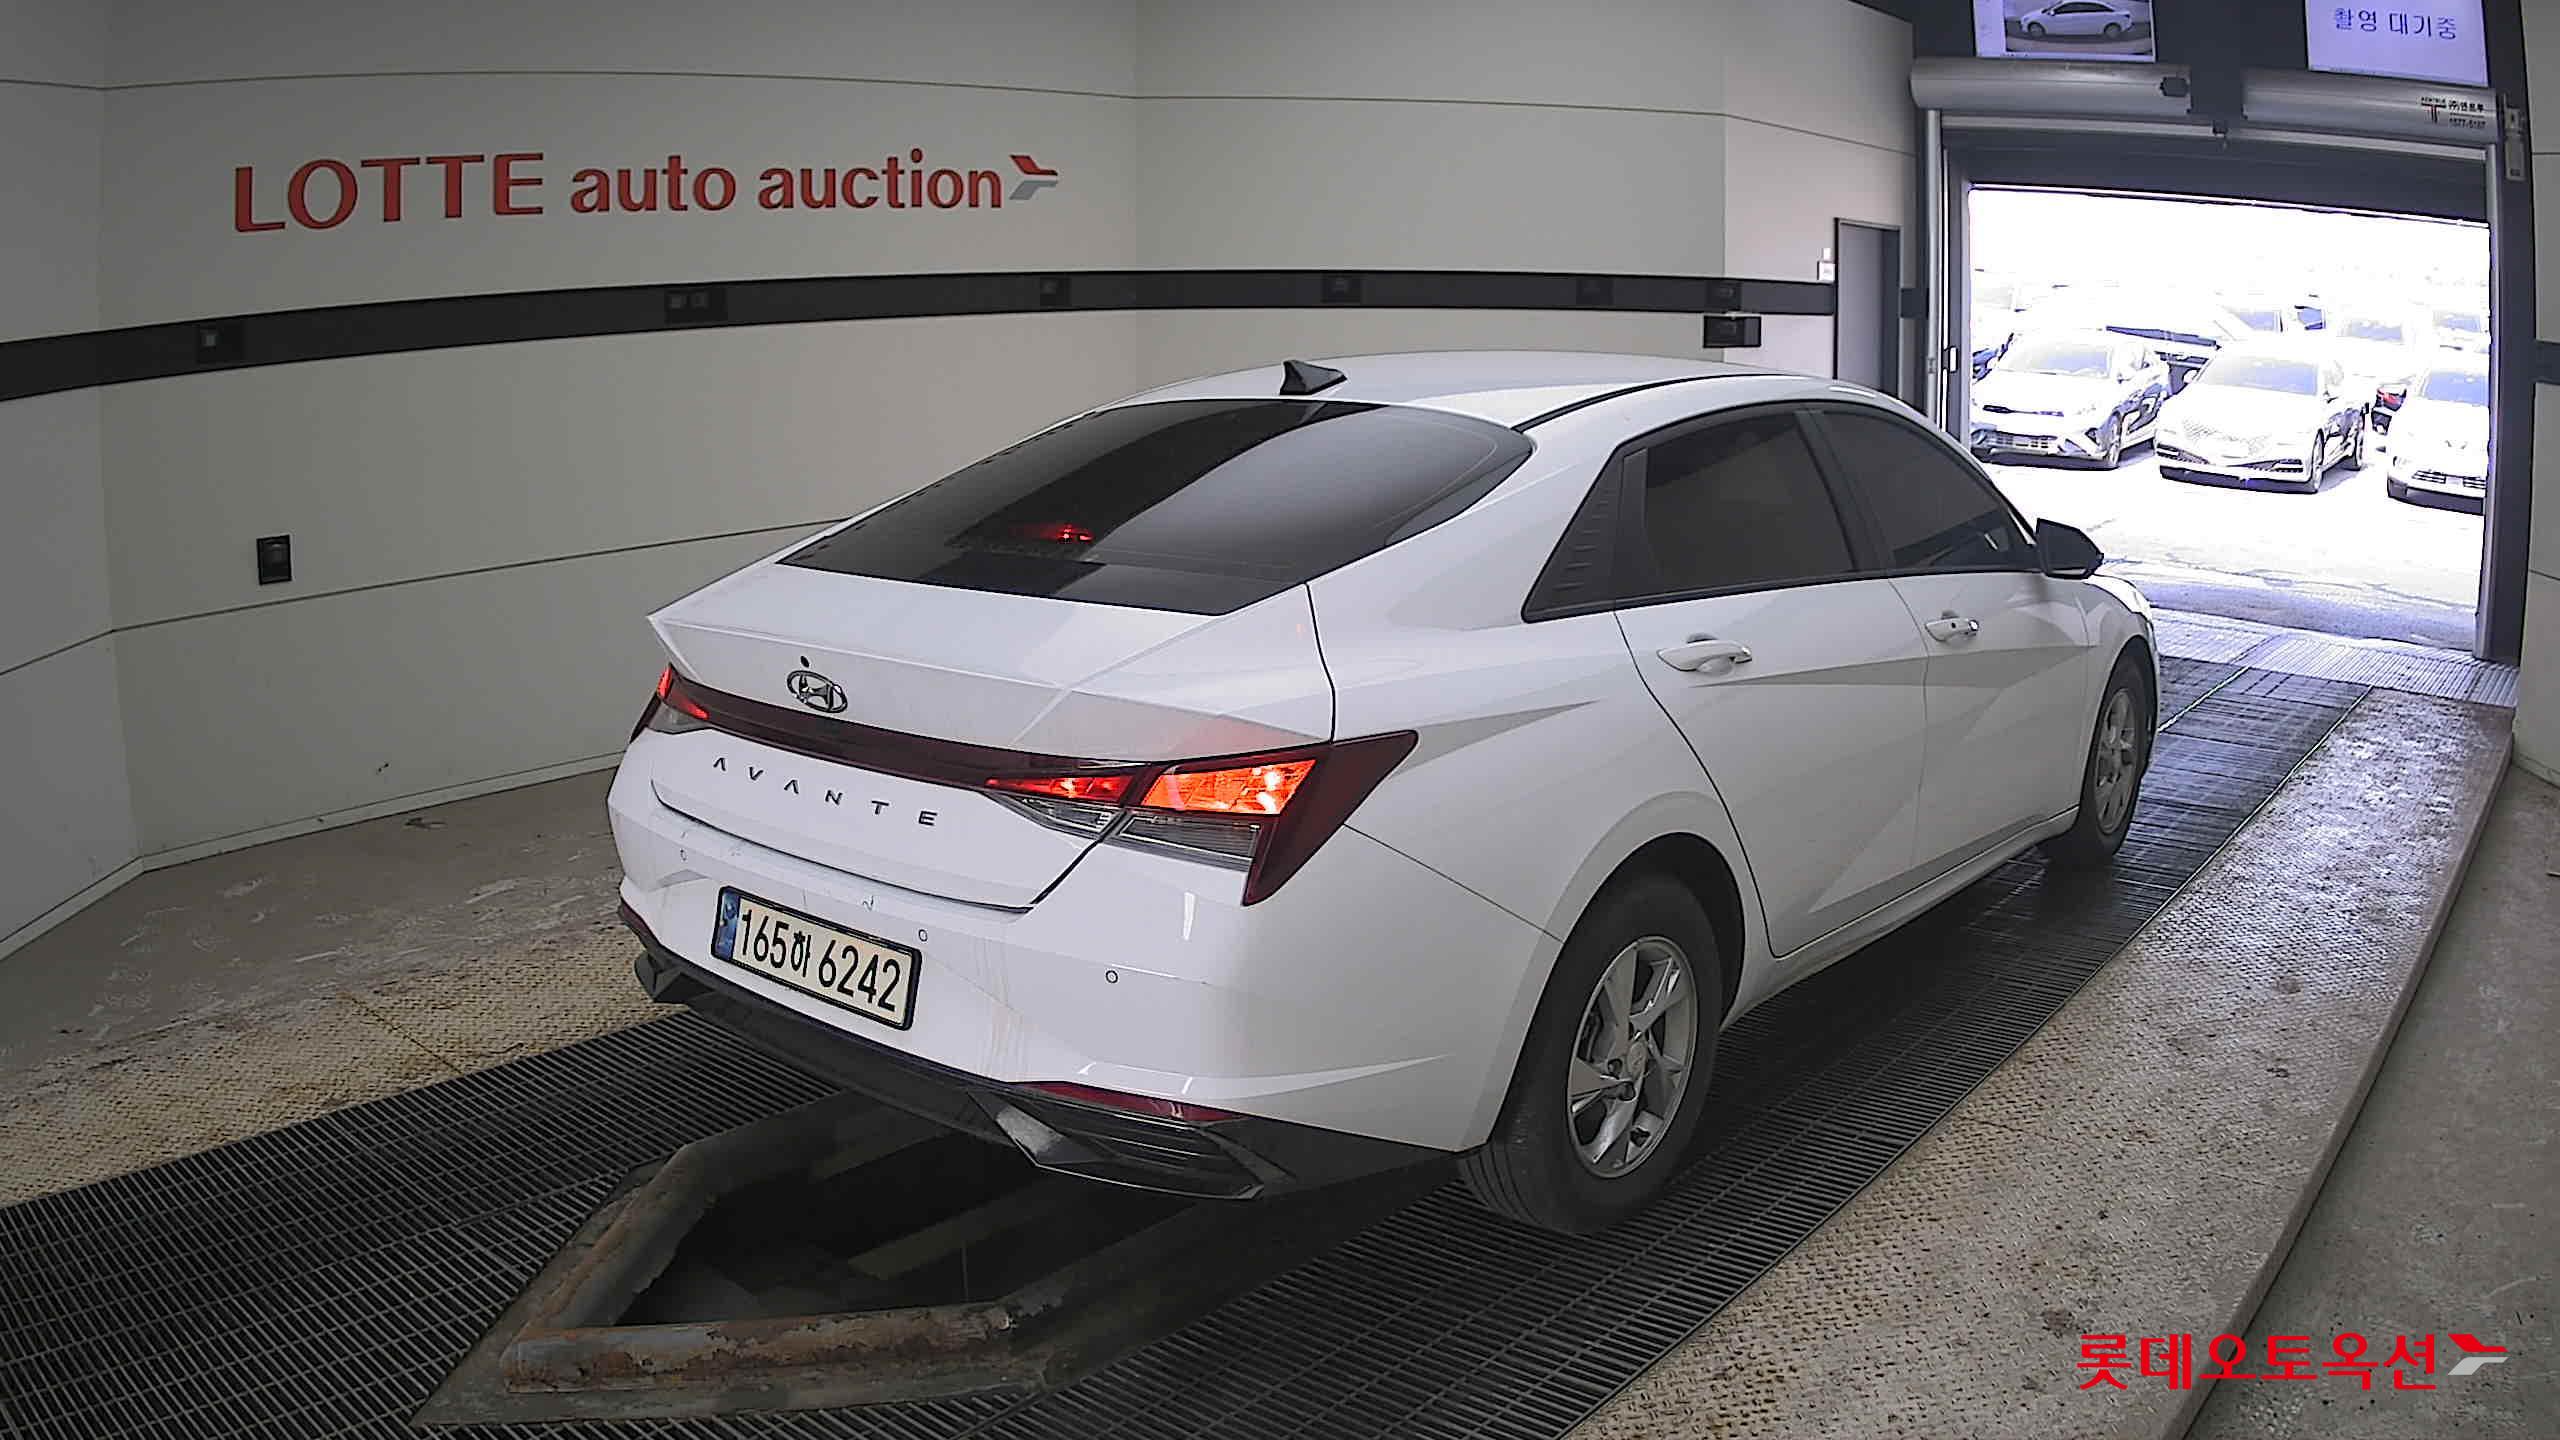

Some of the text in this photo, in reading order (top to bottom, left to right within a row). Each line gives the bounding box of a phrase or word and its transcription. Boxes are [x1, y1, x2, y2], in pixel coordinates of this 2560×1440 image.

[2336, 8, 2456, 40] 촬영 대기중
[235, 147, 1003, 232] LOTTE auto auction
[713, 757, 938, 827] AVANTE
[741, 909, 901, 1013] 165하 6242
